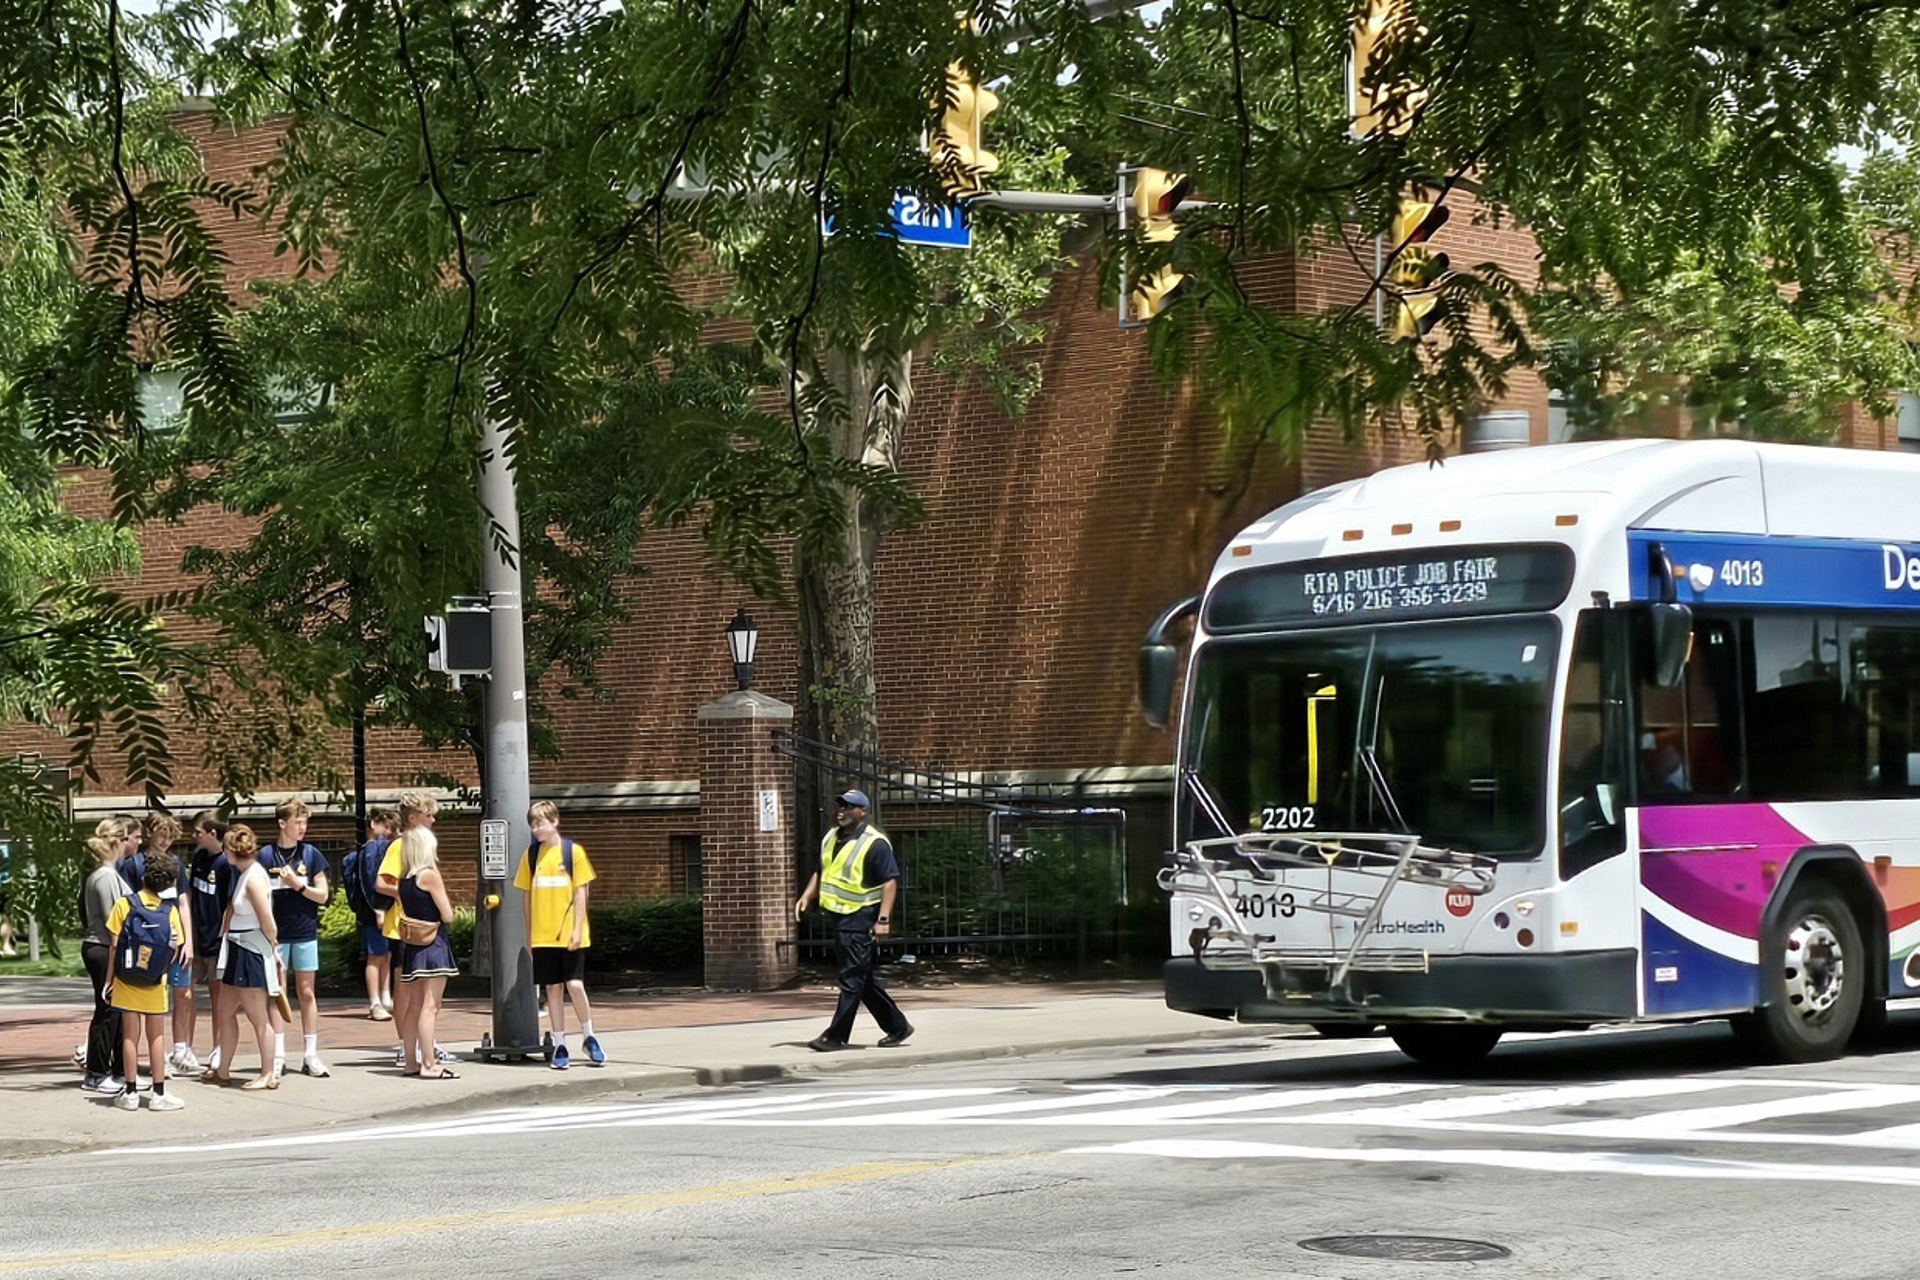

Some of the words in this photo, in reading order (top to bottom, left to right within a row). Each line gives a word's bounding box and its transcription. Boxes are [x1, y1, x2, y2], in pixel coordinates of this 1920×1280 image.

[1304, 572, 1339, 595] RTA
[1345, 565, 1408, 592] POLICE
[1414, 561, 1448, 585] JOB
[1453, 558, 1498, 580] FAIR
[1720, 560, 1764, 586] 4013
[1262, 806, 1316, 830] 2202
[1235, 892, 1296, 919] 4013
